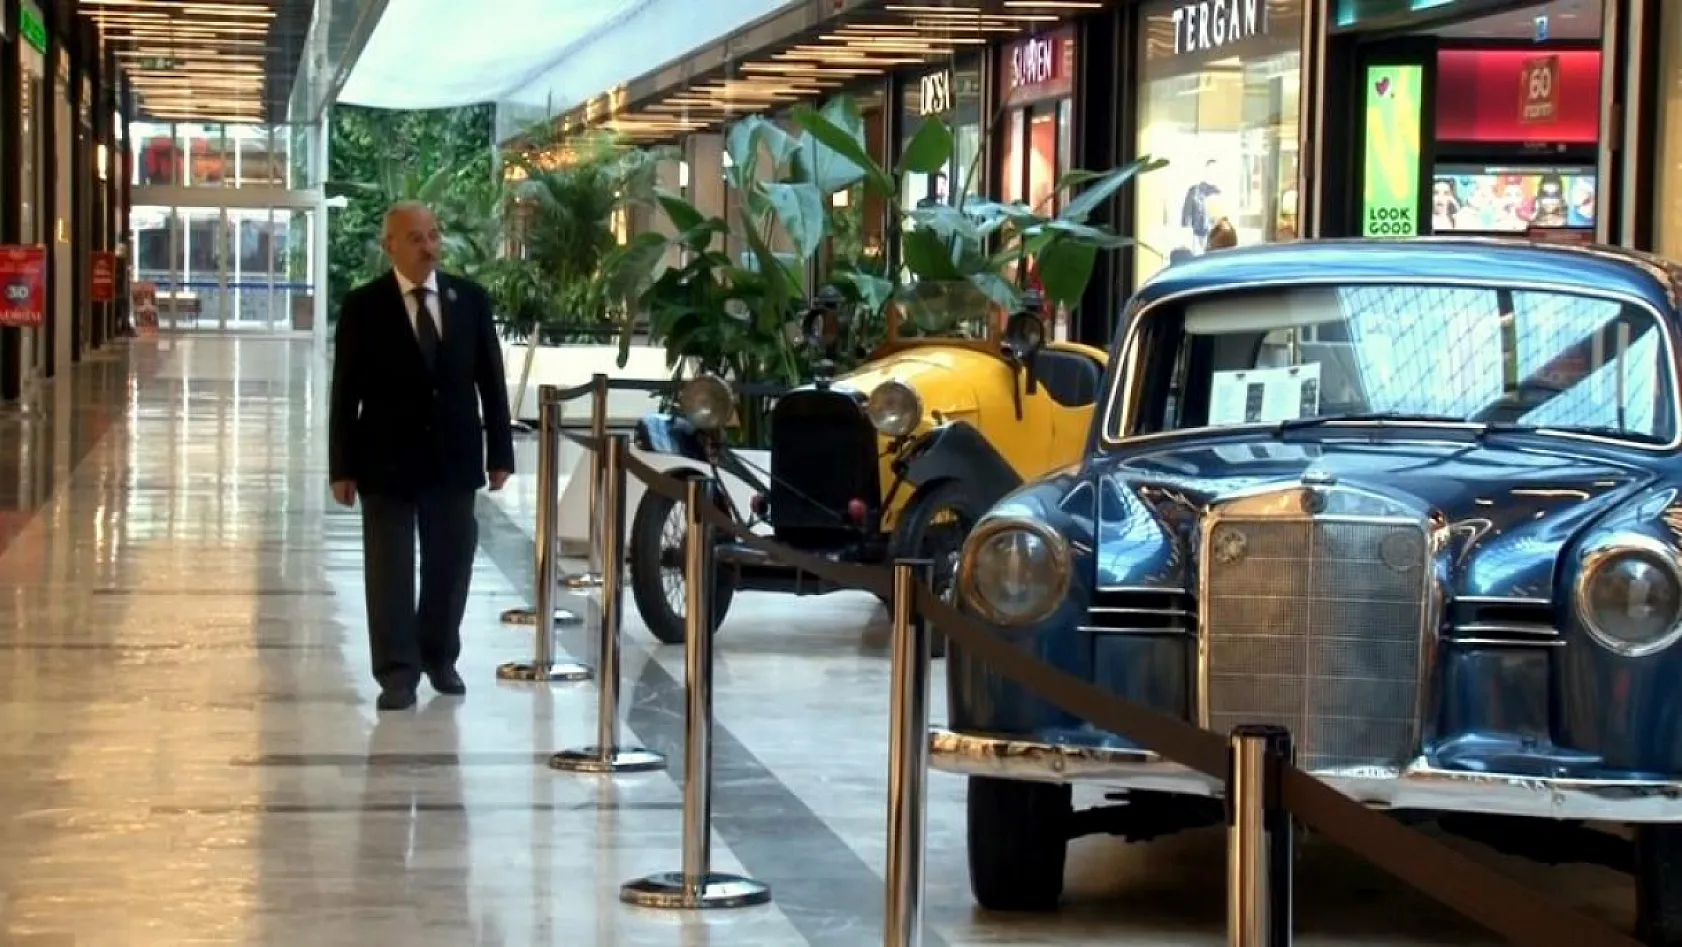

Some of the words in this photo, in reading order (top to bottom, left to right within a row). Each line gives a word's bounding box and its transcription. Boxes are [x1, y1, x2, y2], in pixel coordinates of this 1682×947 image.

[1172, 0, 1257, 55] TERGAN
[1369, 206, 1411, 221] LOOK
[1369, 221, 1412, 235] GOOD
